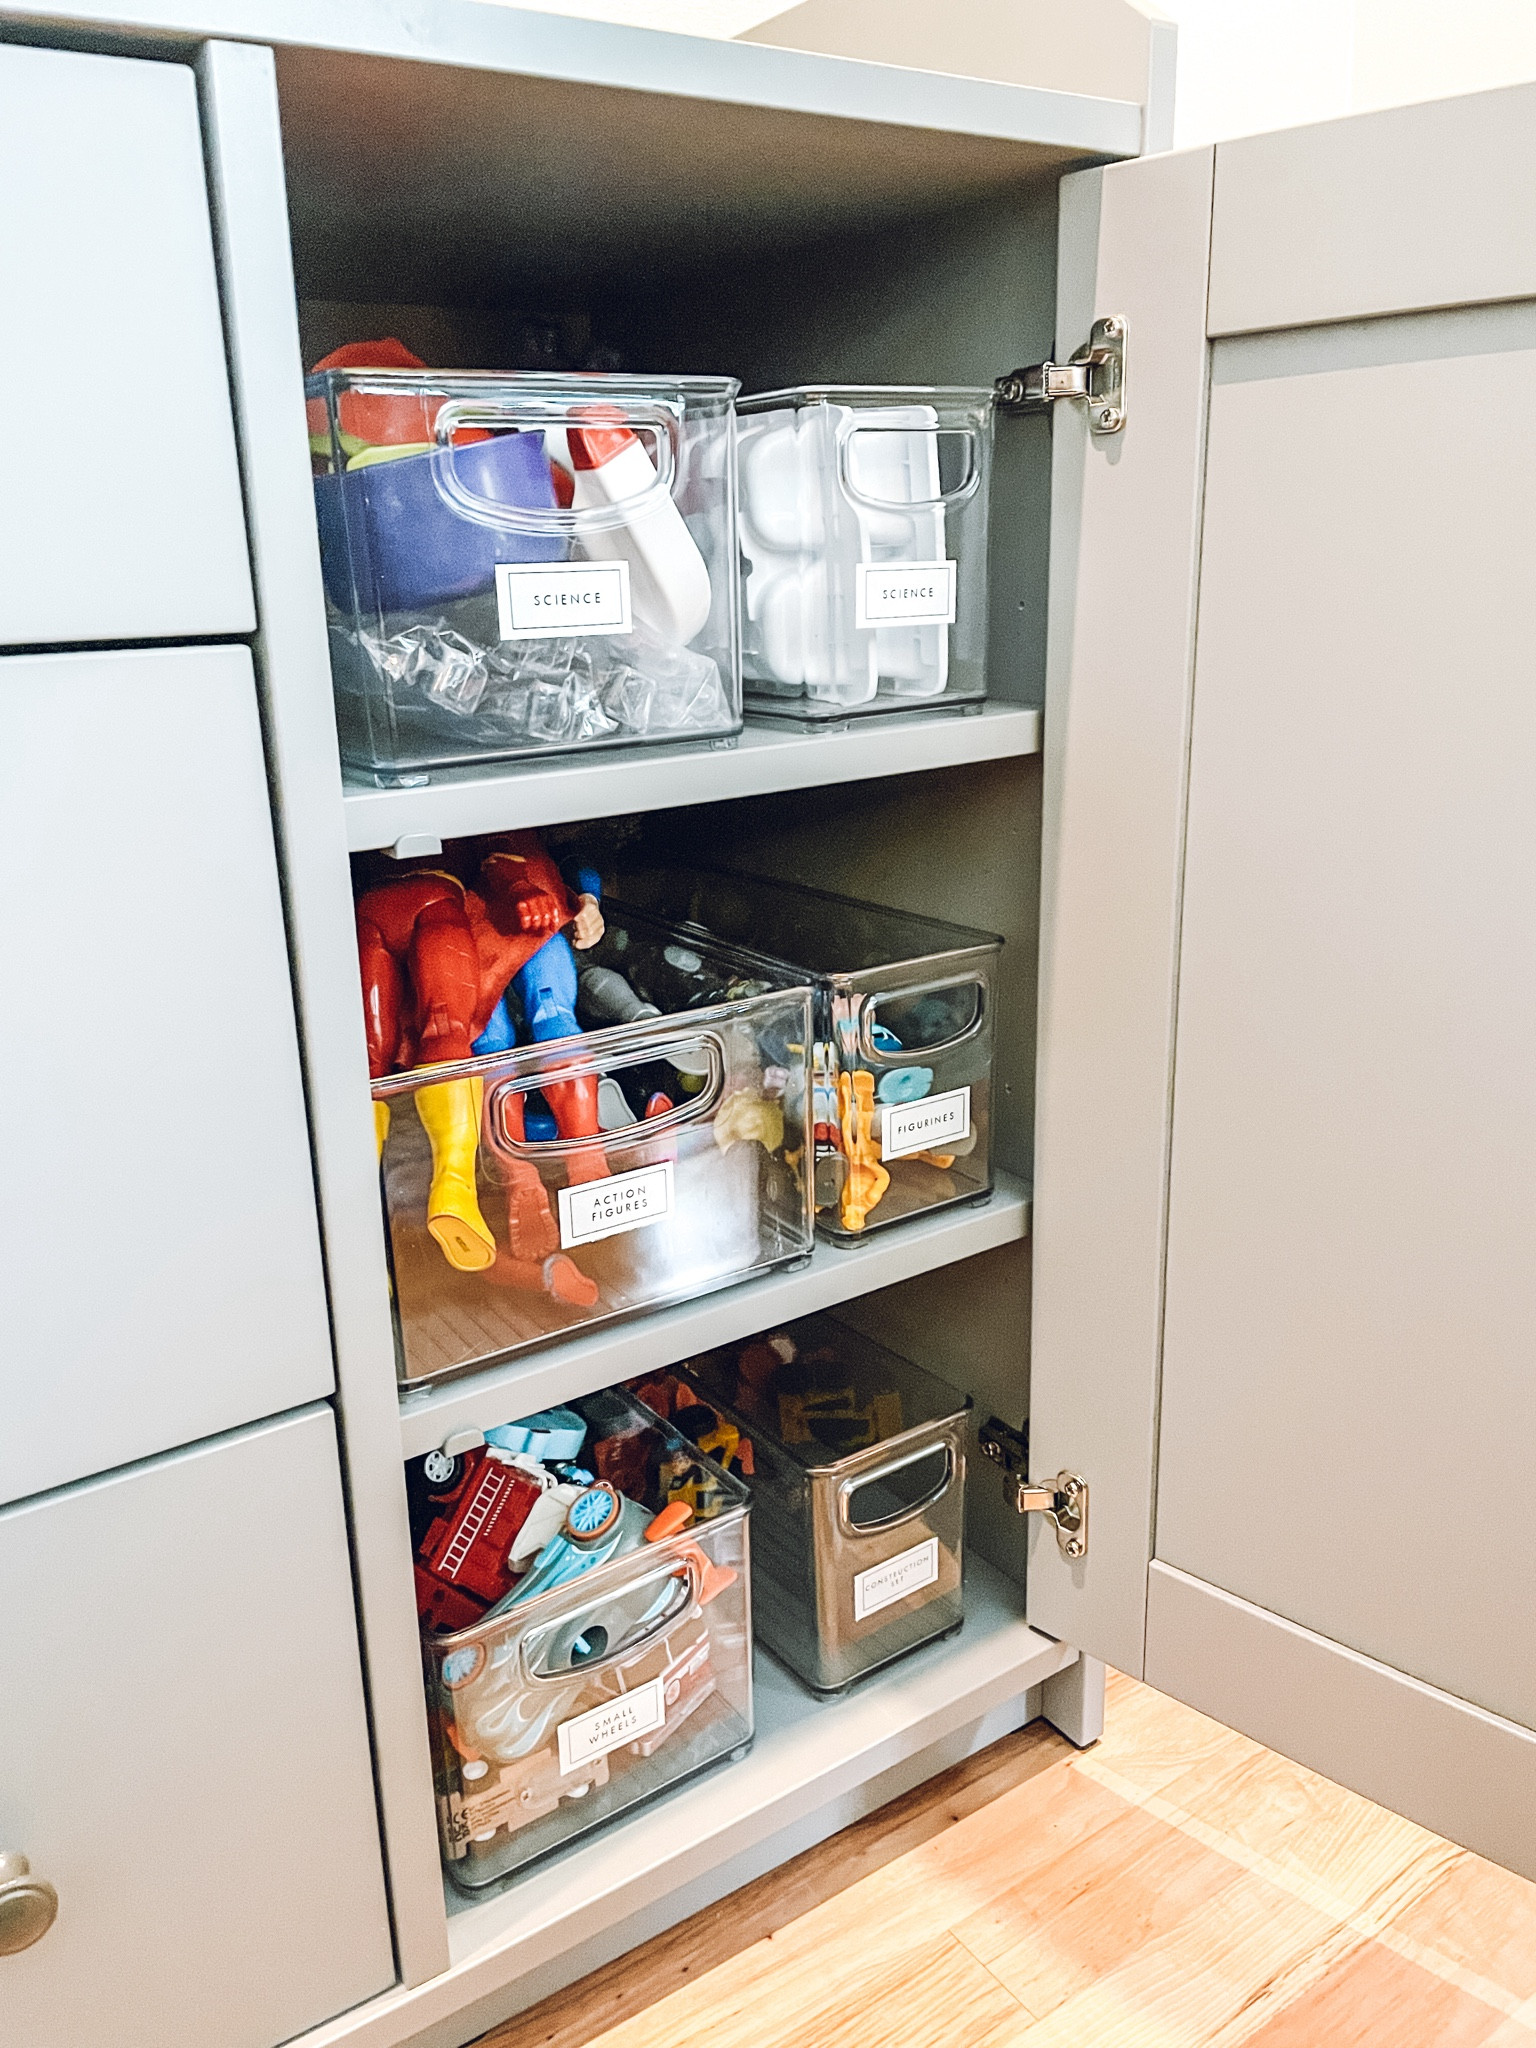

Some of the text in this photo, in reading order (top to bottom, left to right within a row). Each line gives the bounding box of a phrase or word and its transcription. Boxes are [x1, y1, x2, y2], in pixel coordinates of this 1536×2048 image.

[533, 592, 601, 606] SCIENCE
[882, 587, 934, 600] SCIENCE
[897, 1111, 955, 1135] FIGURINES
[593, 1186, 646, 1208] ACTION
[592, 1198, 648, 1222] FIGURES
[865, 1555, 930, 1592] CONSTRUCTION
[588, 1715, 637, 1745] WHEELS
[594, 1706, 633, 1731] SMALL
